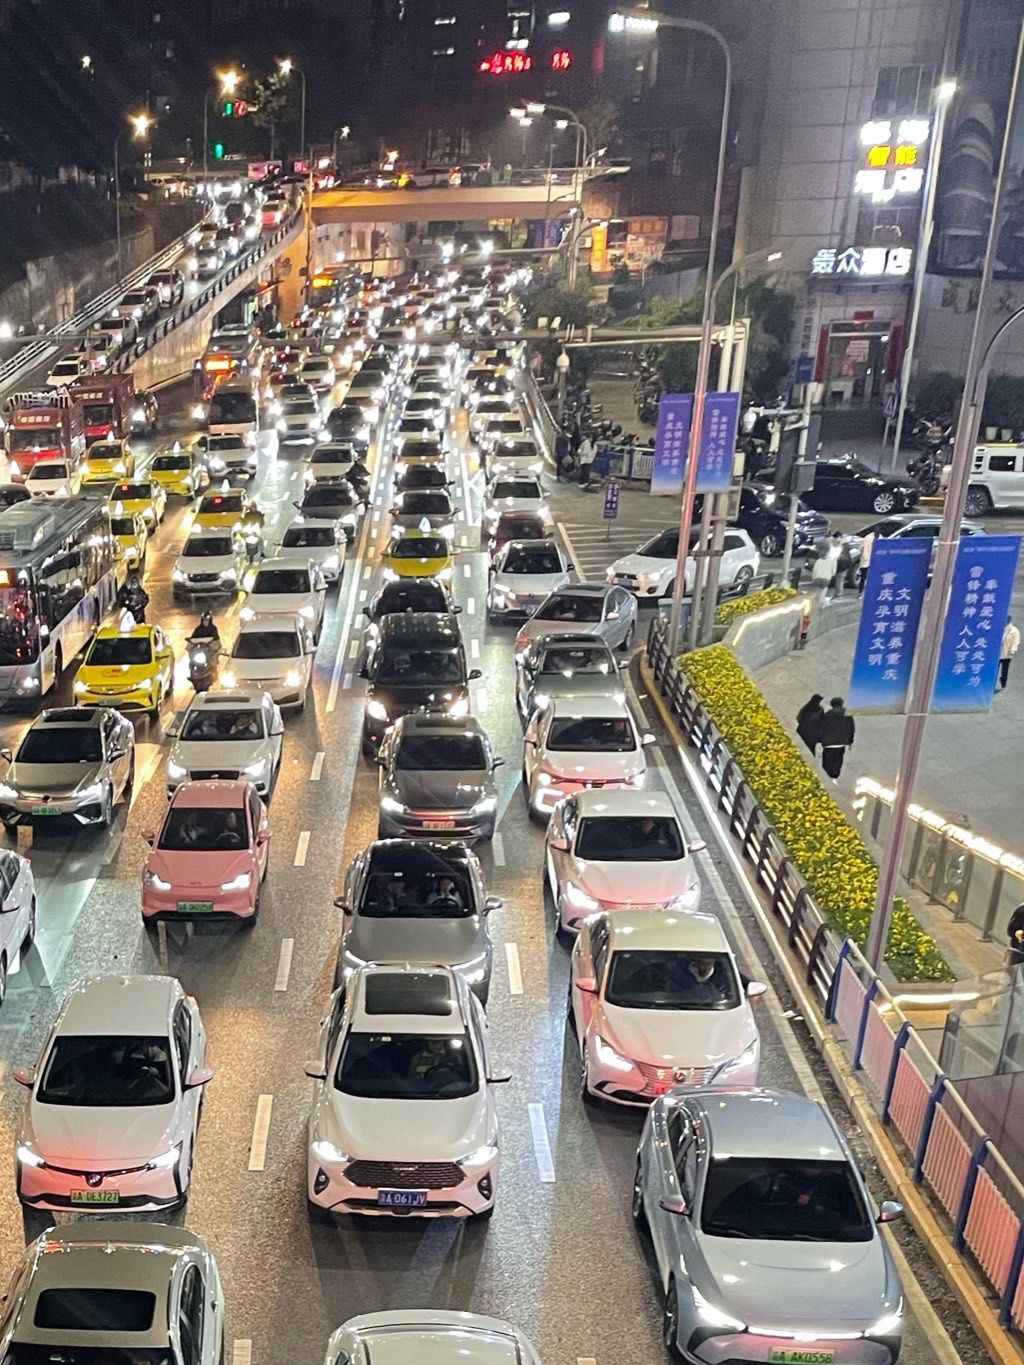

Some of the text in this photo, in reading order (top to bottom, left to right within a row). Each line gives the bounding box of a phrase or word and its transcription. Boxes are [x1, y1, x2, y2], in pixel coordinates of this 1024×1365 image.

[868, 571, 898, 665] 重庆孕育文明
